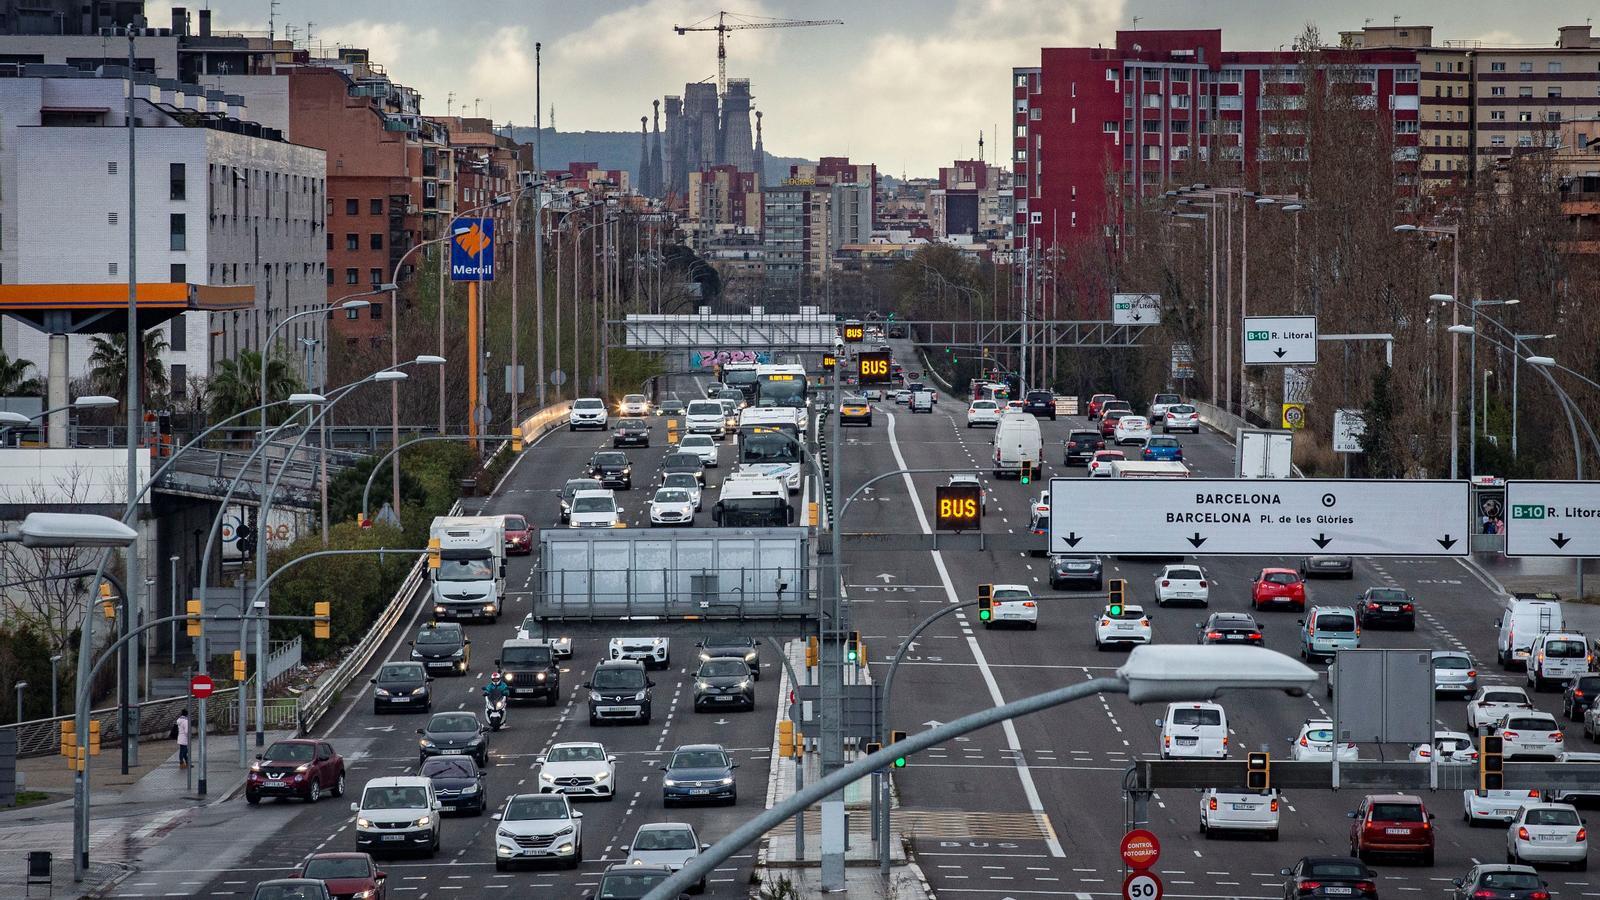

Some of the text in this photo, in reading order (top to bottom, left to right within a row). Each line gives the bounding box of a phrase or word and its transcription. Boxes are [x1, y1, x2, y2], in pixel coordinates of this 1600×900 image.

[453, 265, 492, 275] Meroil
[846, 328, 862, 338] BUS
[1248, 332, 1313, 340] B-10 R. Litoral
[861, 360, 888, 375] BUS
[1289, 412, 1299, 420] 50
[1196, 493, 1281, 504] BARCELONA
[940, 498, 976, 518] BUS
[1514, 507, 1543, 518] B-10
[1547, 507, 1559, 517] R.
[1166, 512, 1354, 524] BARCELONA Pl. de les Glòries
[940, 841, 1019, 849] BUS
[1131, 883, 1154, 898] 50
